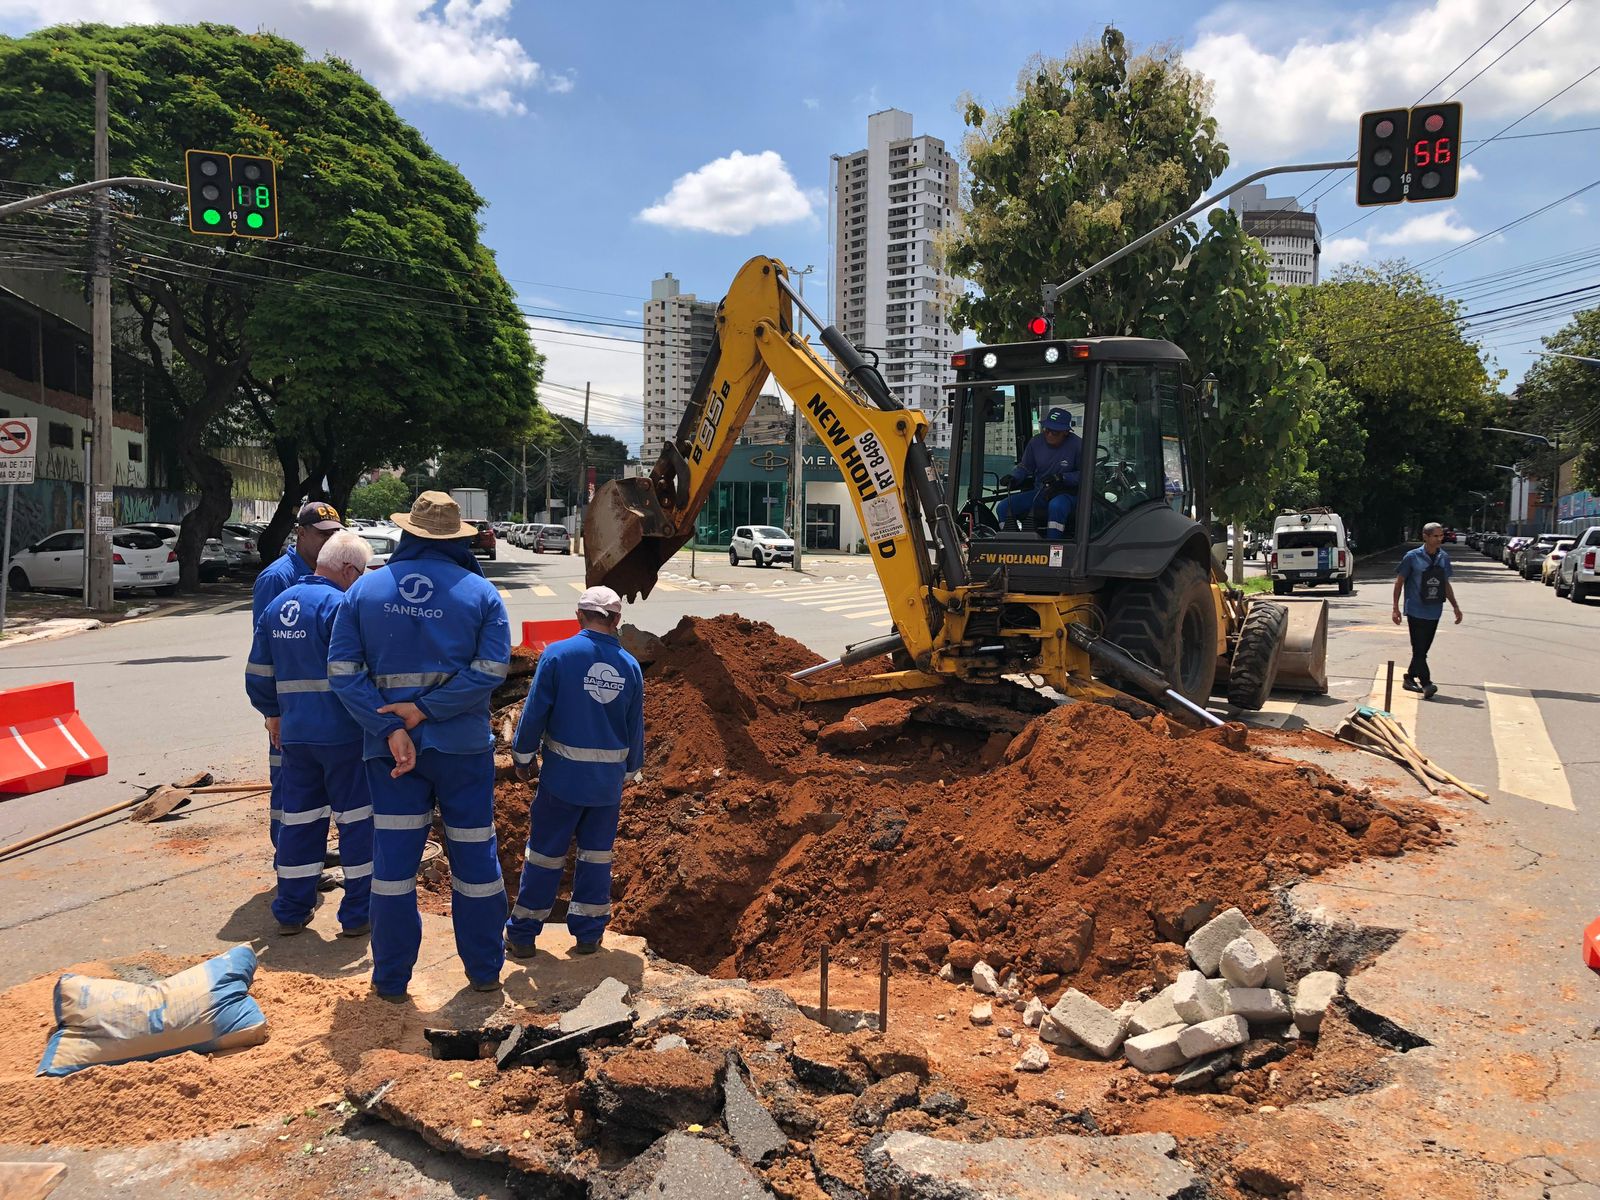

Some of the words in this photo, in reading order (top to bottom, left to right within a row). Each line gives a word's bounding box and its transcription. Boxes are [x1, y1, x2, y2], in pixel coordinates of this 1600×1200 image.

[1414, 138, 1451, 166] 56
[1400, 173, 1412, 183] 16
[238, 185, 270, 208] 18
[1403, 185, 1410, 194] B
[228, 211, 238, 220] 16
[807, 393, 850, 447] NEW
[859, 432, 885, 468] 8486
[874, 469, 895, 490] RT
[998, 554, 1048, 564] HOLLAND
[383, 602, 444, 619] SANEAGO
